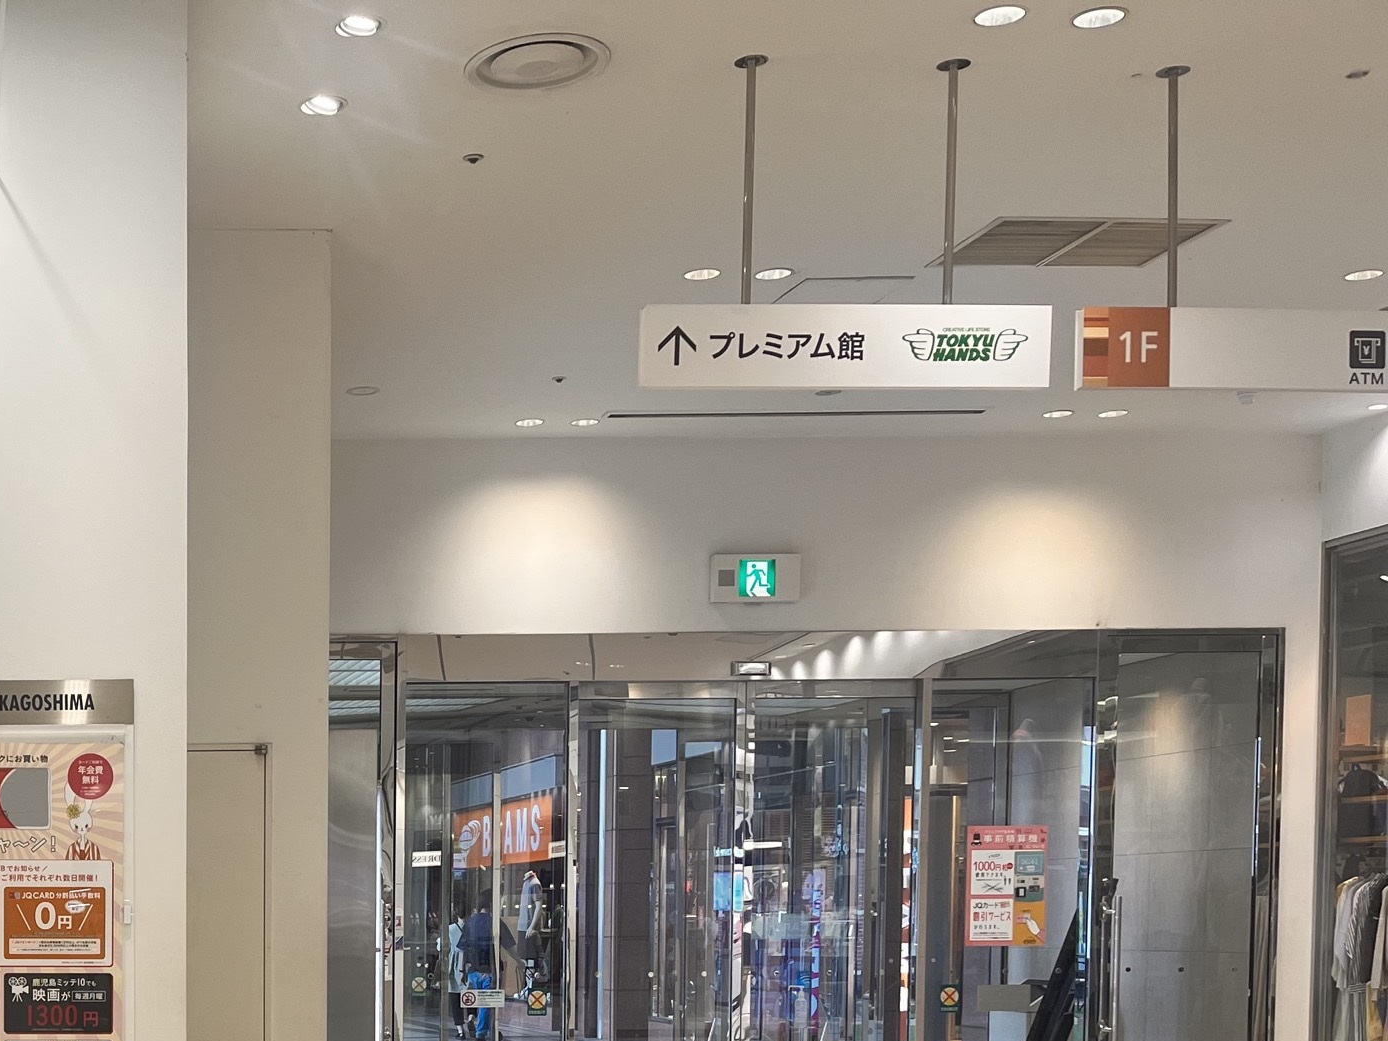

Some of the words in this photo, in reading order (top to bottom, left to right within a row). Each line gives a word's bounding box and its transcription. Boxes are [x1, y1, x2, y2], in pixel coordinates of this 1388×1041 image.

[709, 331, 865, 361] プレミアム館
[937, 334, 995, 348] TOKYU
[1119, 331, 1158, 363] 1F
[933, 347, 991, 361] HANDS
[1349, 373, 1384, 385] ATM
[0, 694, 95, 711] KAGOSHIMA
[482, 804, 541, 857] BAMS
[32, 988, 71, 1001] 映画が
